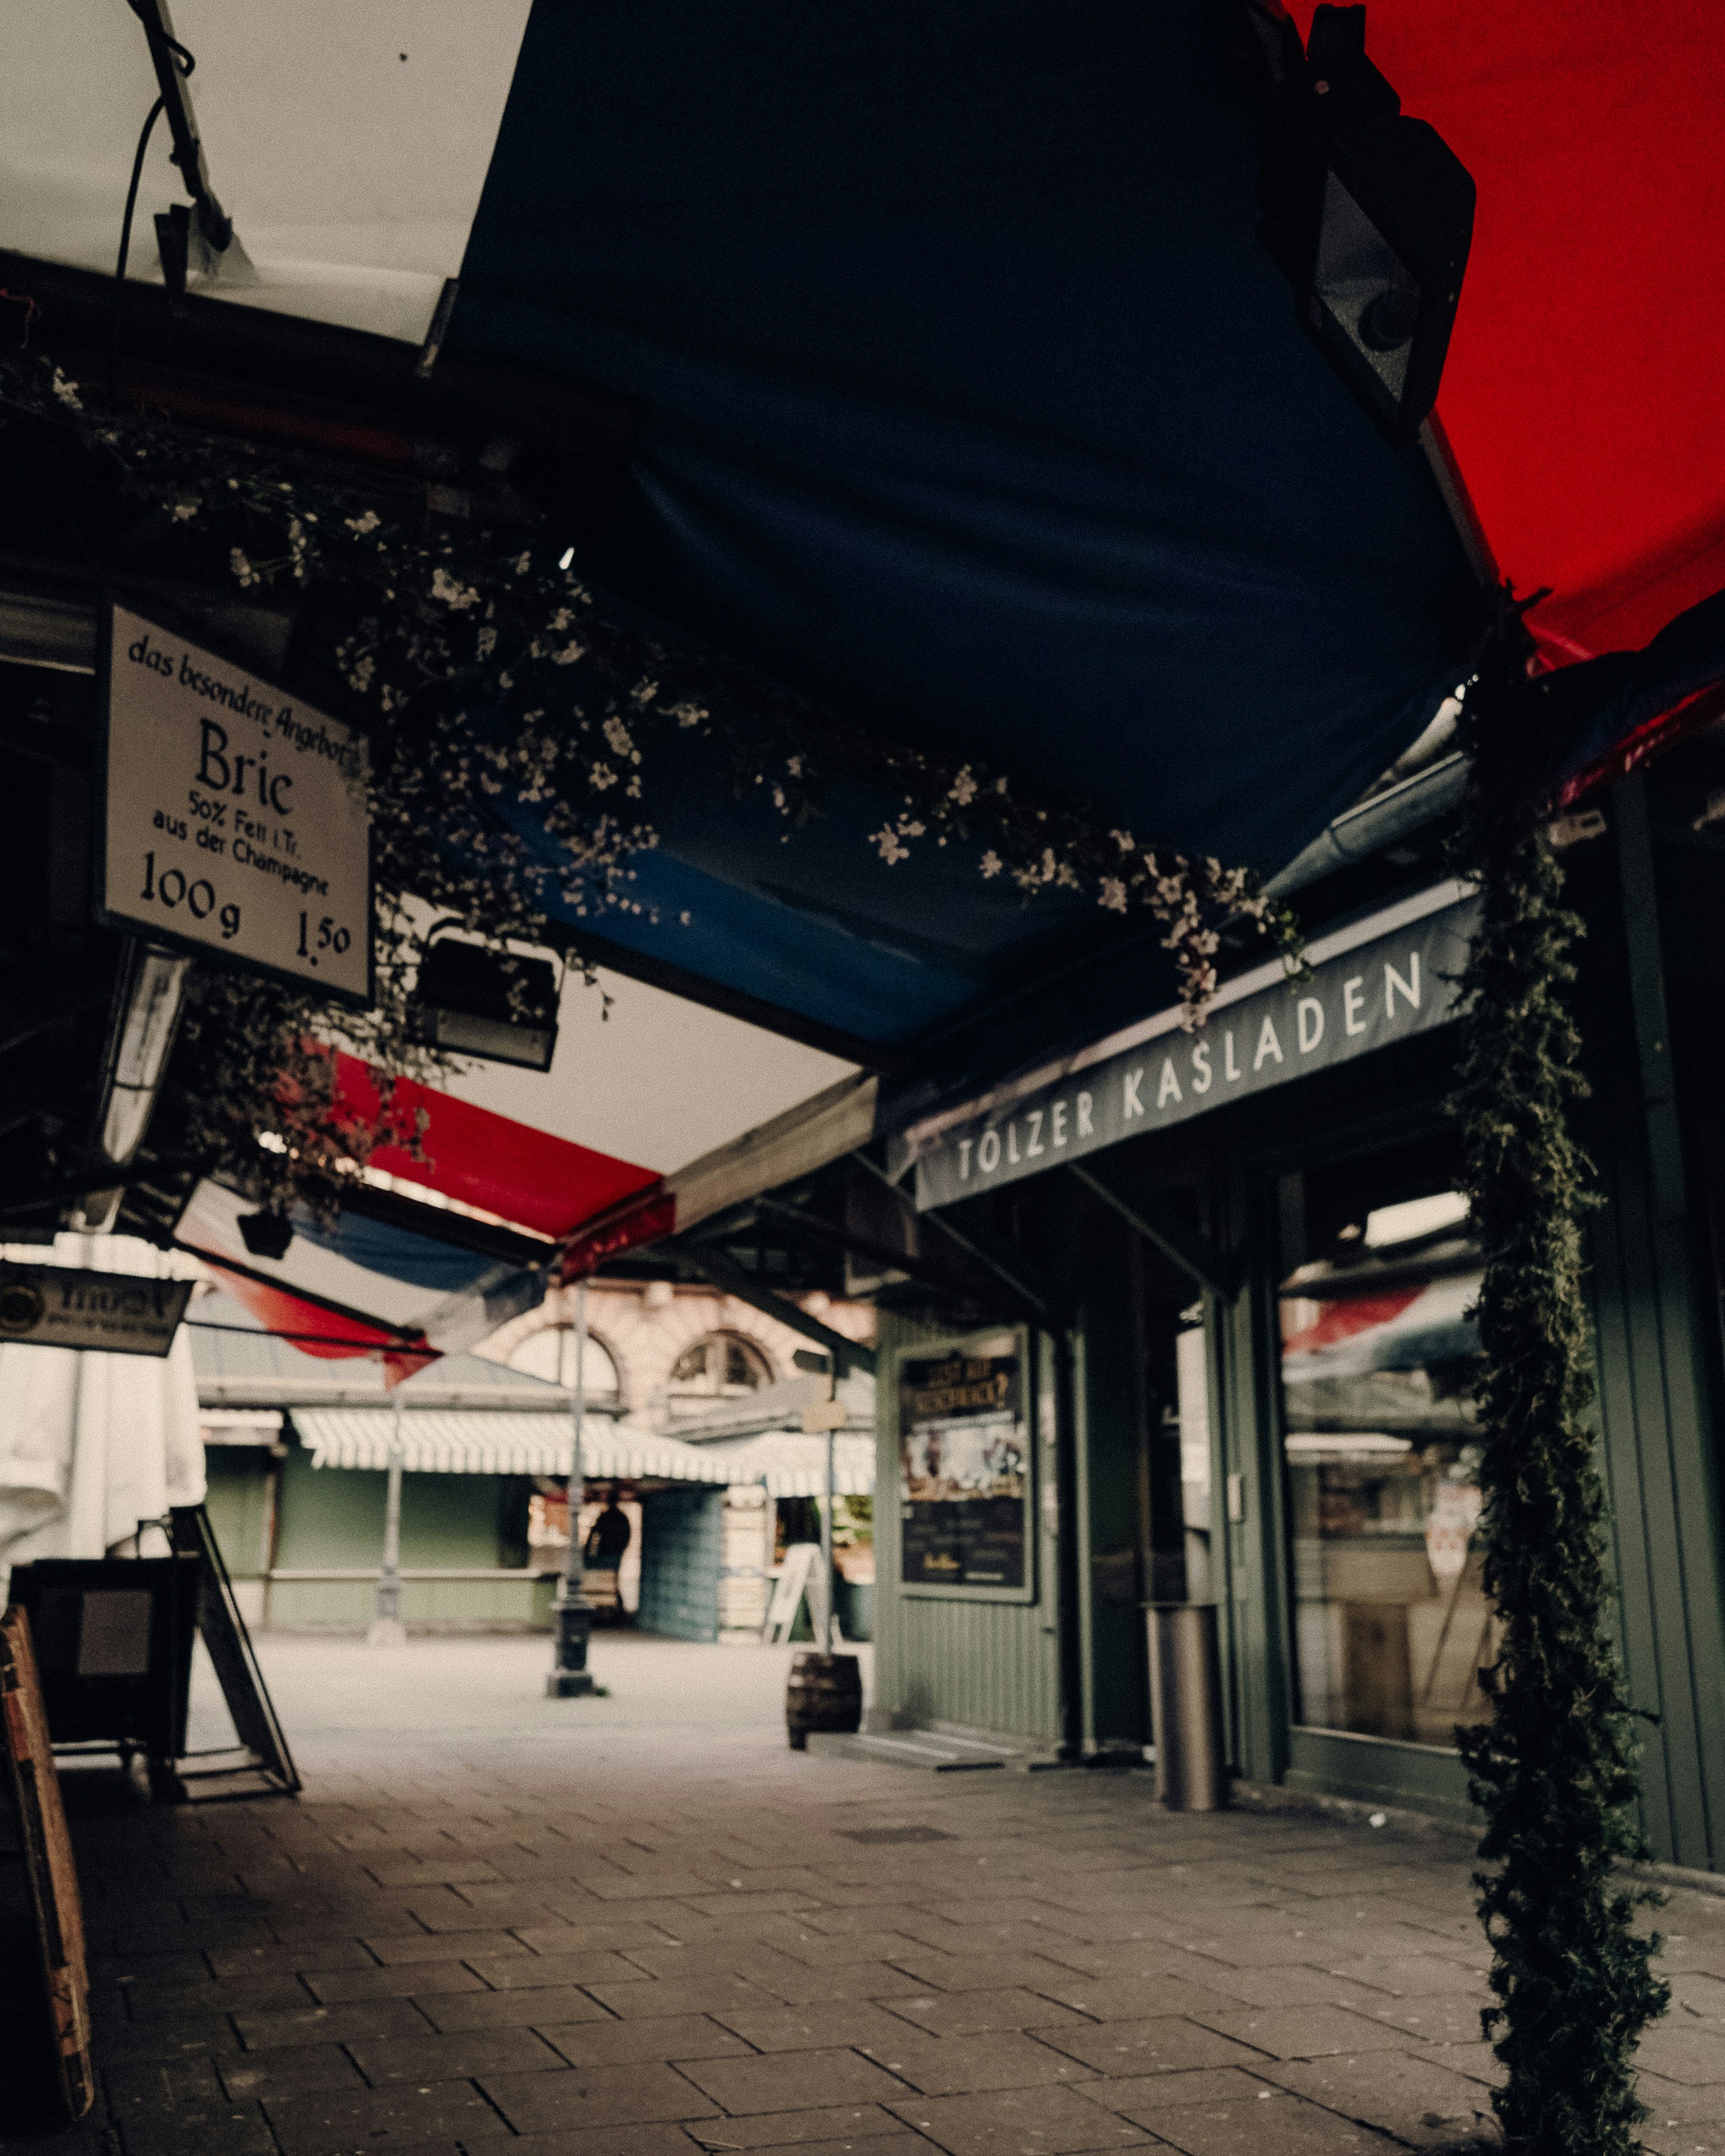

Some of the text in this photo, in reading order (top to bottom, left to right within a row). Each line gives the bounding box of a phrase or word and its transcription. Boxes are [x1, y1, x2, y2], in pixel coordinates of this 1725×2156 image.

[128, 635, 173, 677] das
[188, 790, 227, 827] 50%
[153, 809, 329, 897] aus der Champagne
[1123, 951, 1422, 1119] KASLADEN
